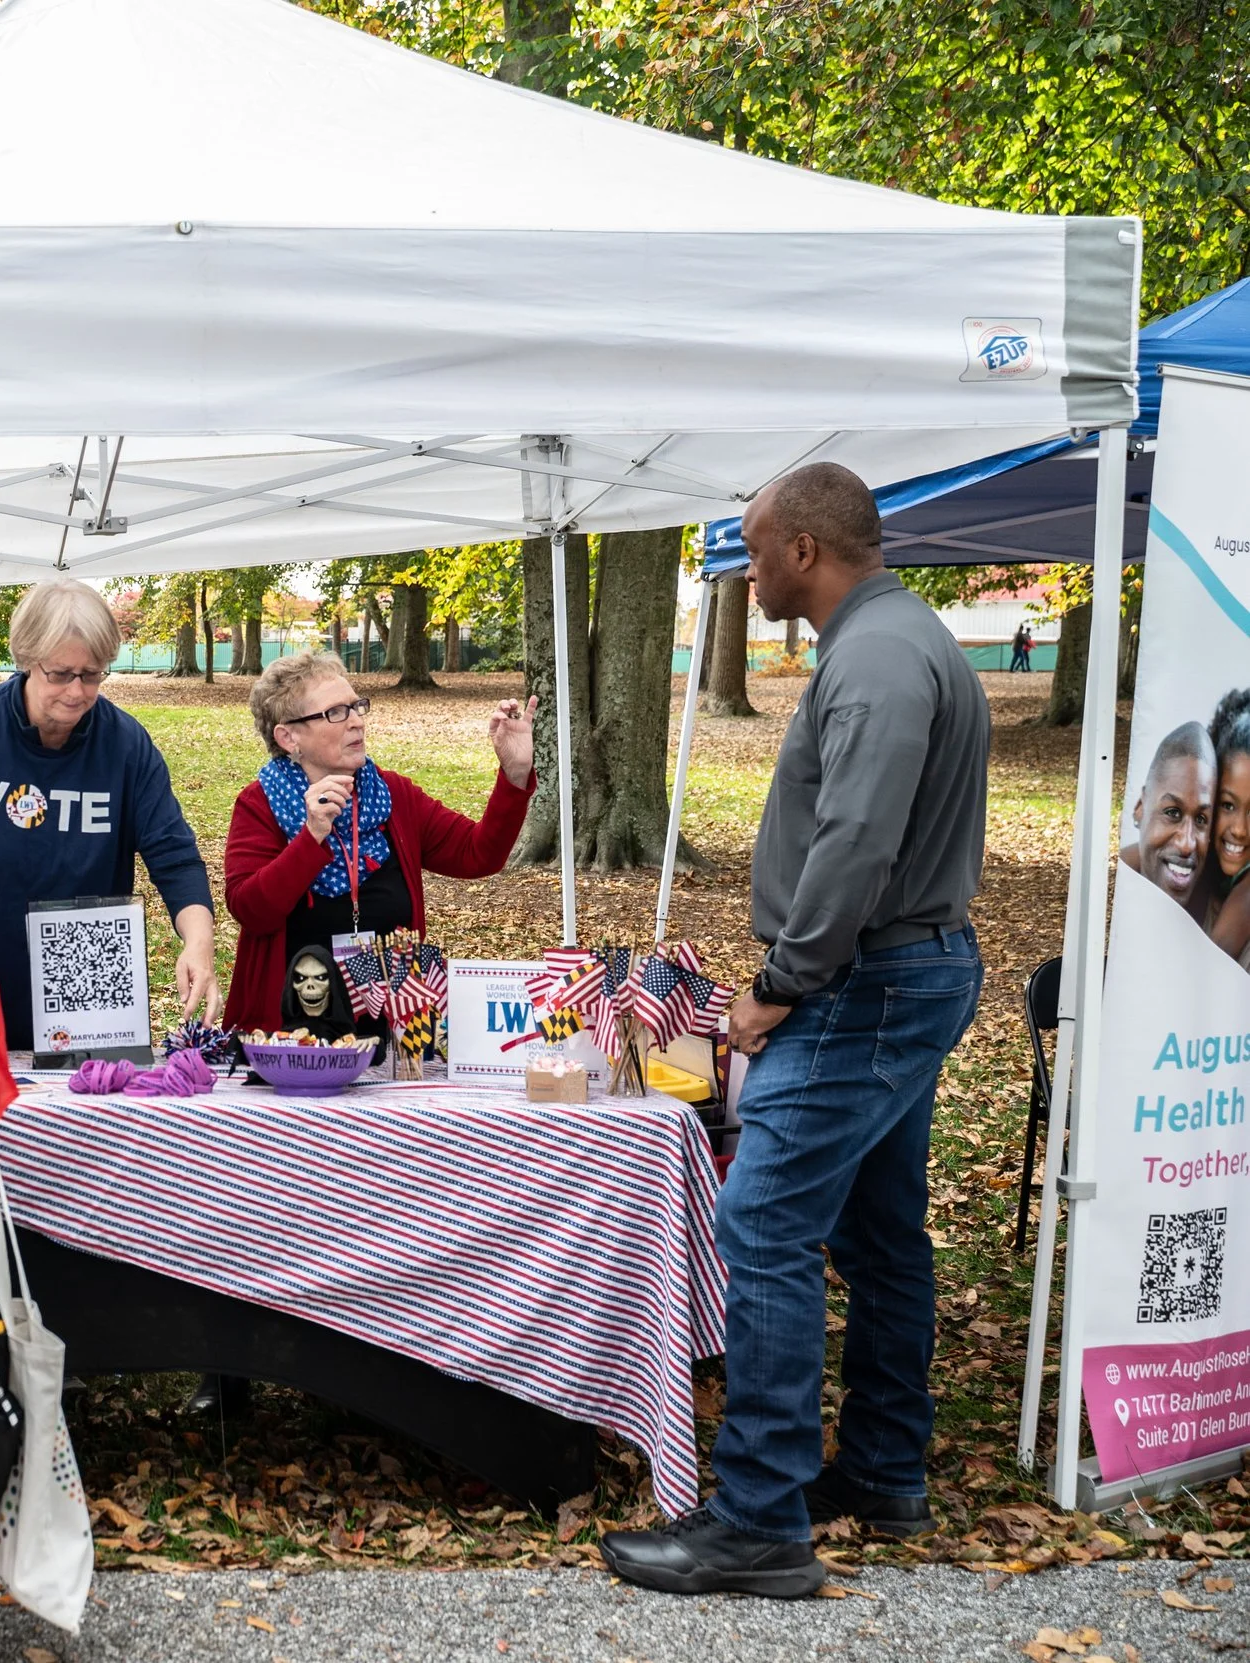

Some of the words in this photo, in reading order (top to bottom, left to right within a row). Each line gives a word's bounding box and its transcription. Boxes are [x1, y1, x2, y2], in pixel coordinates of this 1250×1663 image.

[486, 991, 516, 999] WOMEN
[71, 1032, 112, 1041] MARYLAND
[113, 1031, 135, 1039] STATE
[253, 1053, 282, 1069] HAPPY
[286, 1053, 360, 1071] HALLOWEEN
[1134, 1087, 1245, 1133] Health
[1143, 1150, 1249, 1187] Together,
[1131, 1393, 1165, 1418] 7477
[1170, 1388, 1232, 1413] Baltimore
[1137, 1426, 1168, 1449] Suite
[1171, 1422, 1197, 1444] 201
[1200, 1417, 1225, 1438] Glen
